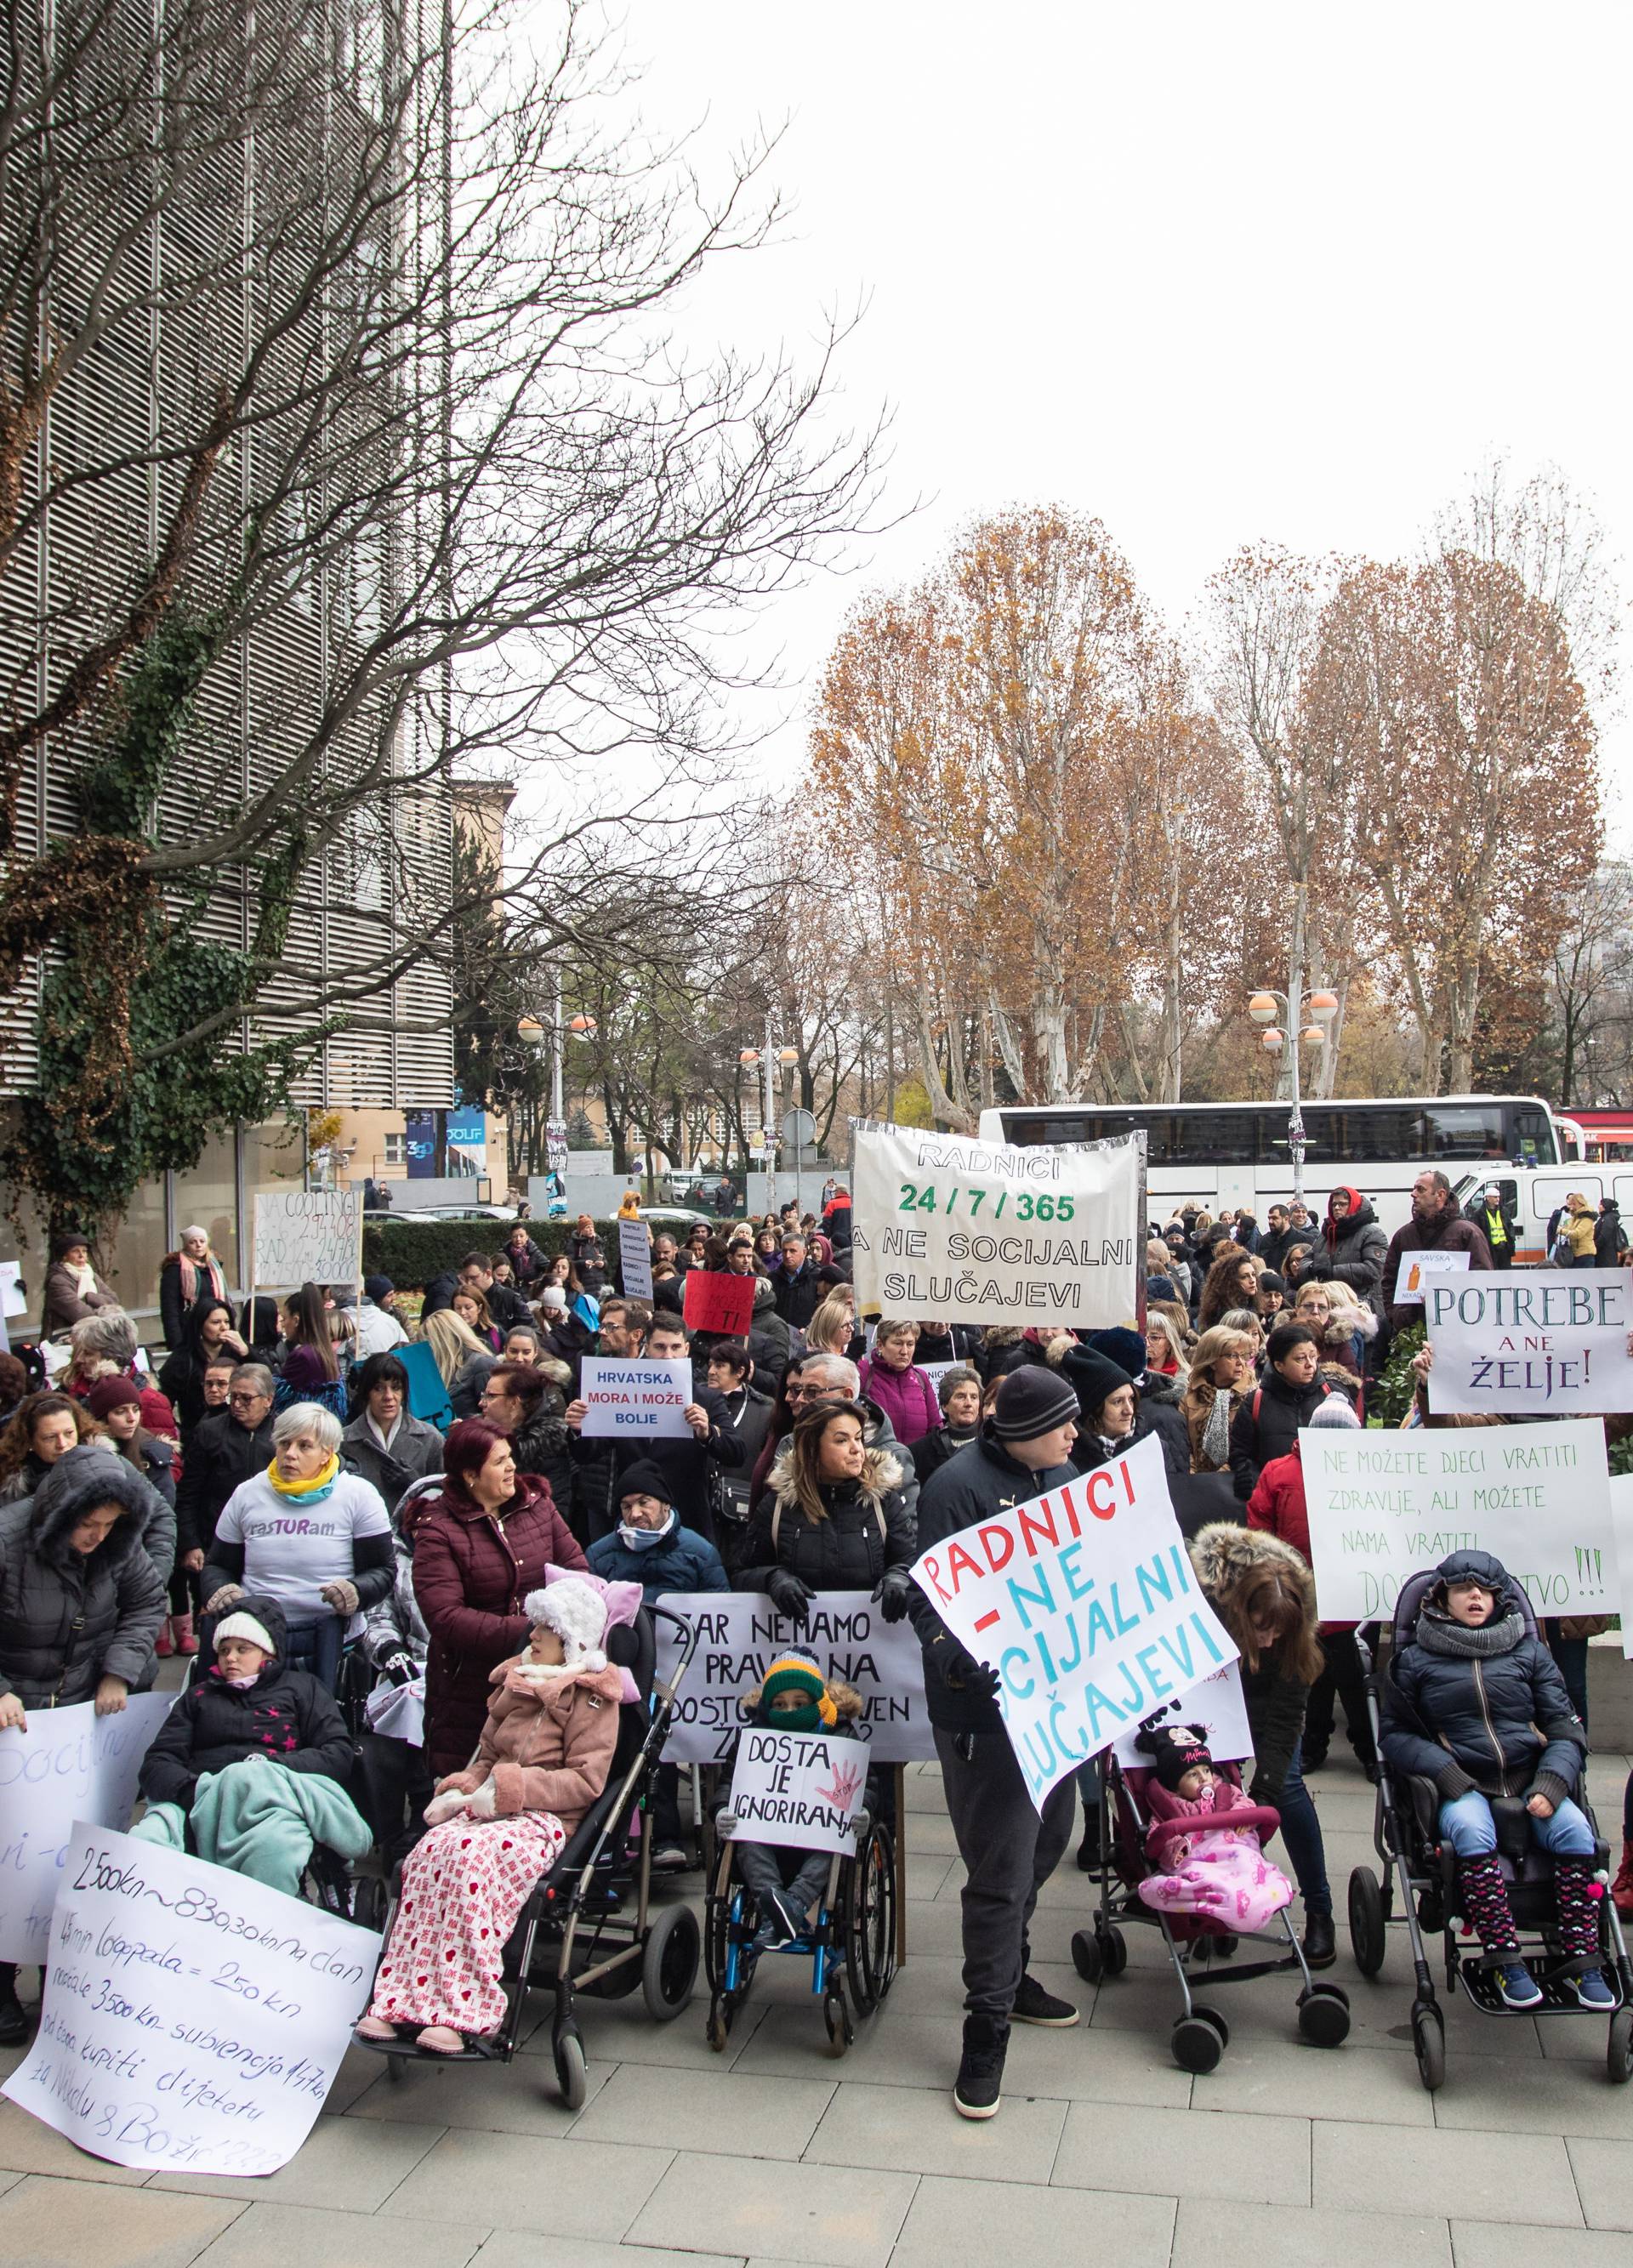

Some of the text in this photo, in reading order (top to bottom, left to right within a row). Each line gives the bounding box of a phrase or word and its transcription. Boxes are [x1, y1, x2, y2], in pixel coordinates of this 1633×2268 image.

[918, 1144, 1060, 1180] RADNICI
[898, 1184, 936, 1214] 24
[968, 1190, 987, 1216] 7
[1016, 1194, 1075, 1222] 365
[882, 1227, 927, 1259] NE
[947, 1233, 1133, 1265] SOCIJALNI
[884, 1270, 1082, 1309] SLUČAJEVI
[721, 1310, 741, 1331] TI
[1432, 1285, 1624, 1331] POTREBE
[1499, 1336, 1554, 1351] A NE
[597, 1372, 673, 1384] HRVATSKA
[588, 1391, 684, 1405] MORA I MOŽE
[615, 1413, 658, 1424] BOLJE
[1324, 1444, 1577, 1475] NE MOŽETE DJECI VRATITI
[1431, 1490, 1458, 1511] ALI
[1474, 1485, 1546, 1510] MOŽETE
[249, 1519, 335, 1536] rasTURam
[923, 1460, 1136, 1608] RADNICI
[1342, 1530, 1477, 1555] NAMA VRATITI
[752, 1612, 871, 1643] NEMAMO
[1000, 1544, 1190, 1721] CIJALNI
[828, 1653, 881, 1683] NA
[748, 1735, 831, 1770] DOSTA
[766, 1765, 794, 1794] JE
[833, 1783, 851, 1799] STOP
[210, 1961, 259, 1999] 250
[80, 2032, 146, 2078] kupiti
